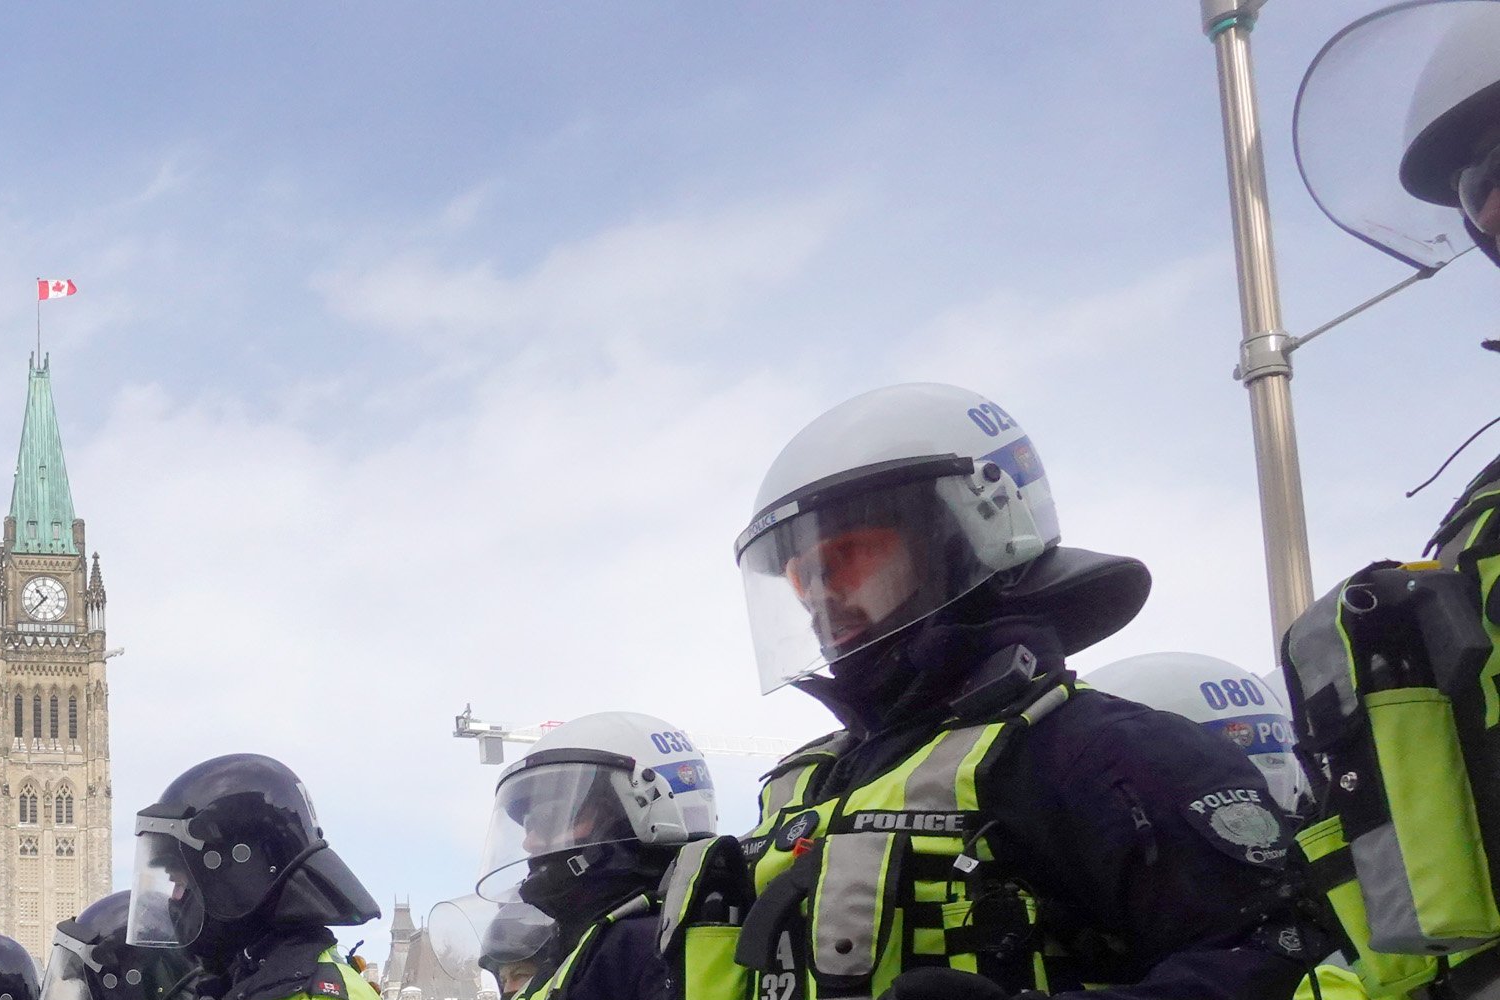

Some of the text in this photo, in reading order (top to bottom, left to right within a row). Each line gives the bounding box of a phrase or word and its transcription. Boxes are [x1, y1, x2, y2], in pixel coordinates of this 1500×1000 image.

[747, 511, 777, 539] POLICE
[1200, 678, 1264, 710] 080
[650, 732, 693, 754] 033
[1189, 789, 1261, 814] POLICE
[854, 813, 964, 831] POLICE
